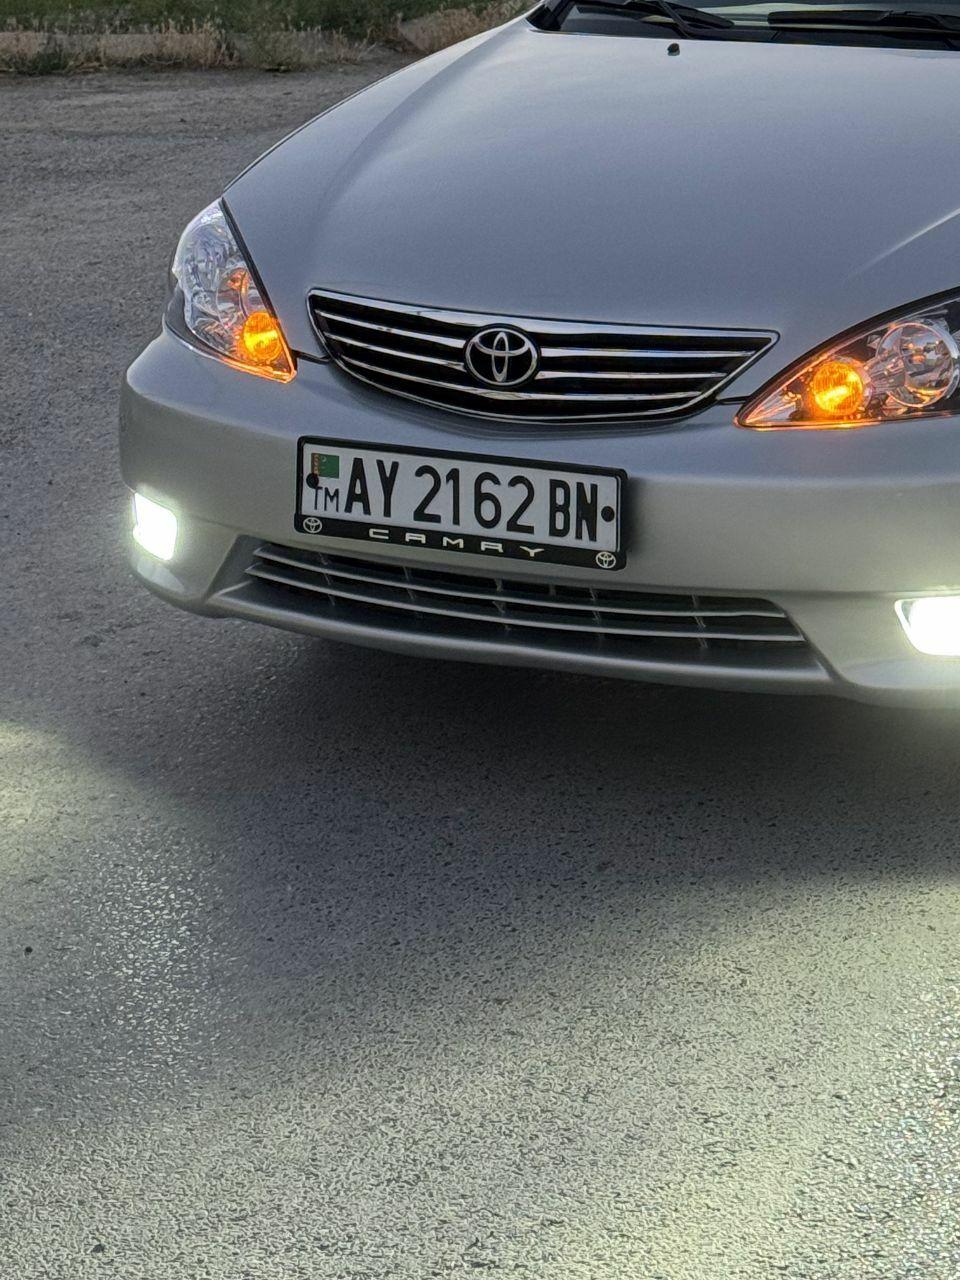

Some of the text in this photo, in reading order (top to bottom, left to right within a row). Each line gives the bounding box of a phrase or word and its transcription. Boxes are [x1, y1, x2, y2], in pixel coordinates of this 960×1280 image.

[313, 457, 598, 542] TM AY 2162 BN
[368, 528, 545, 557] CAMRY
